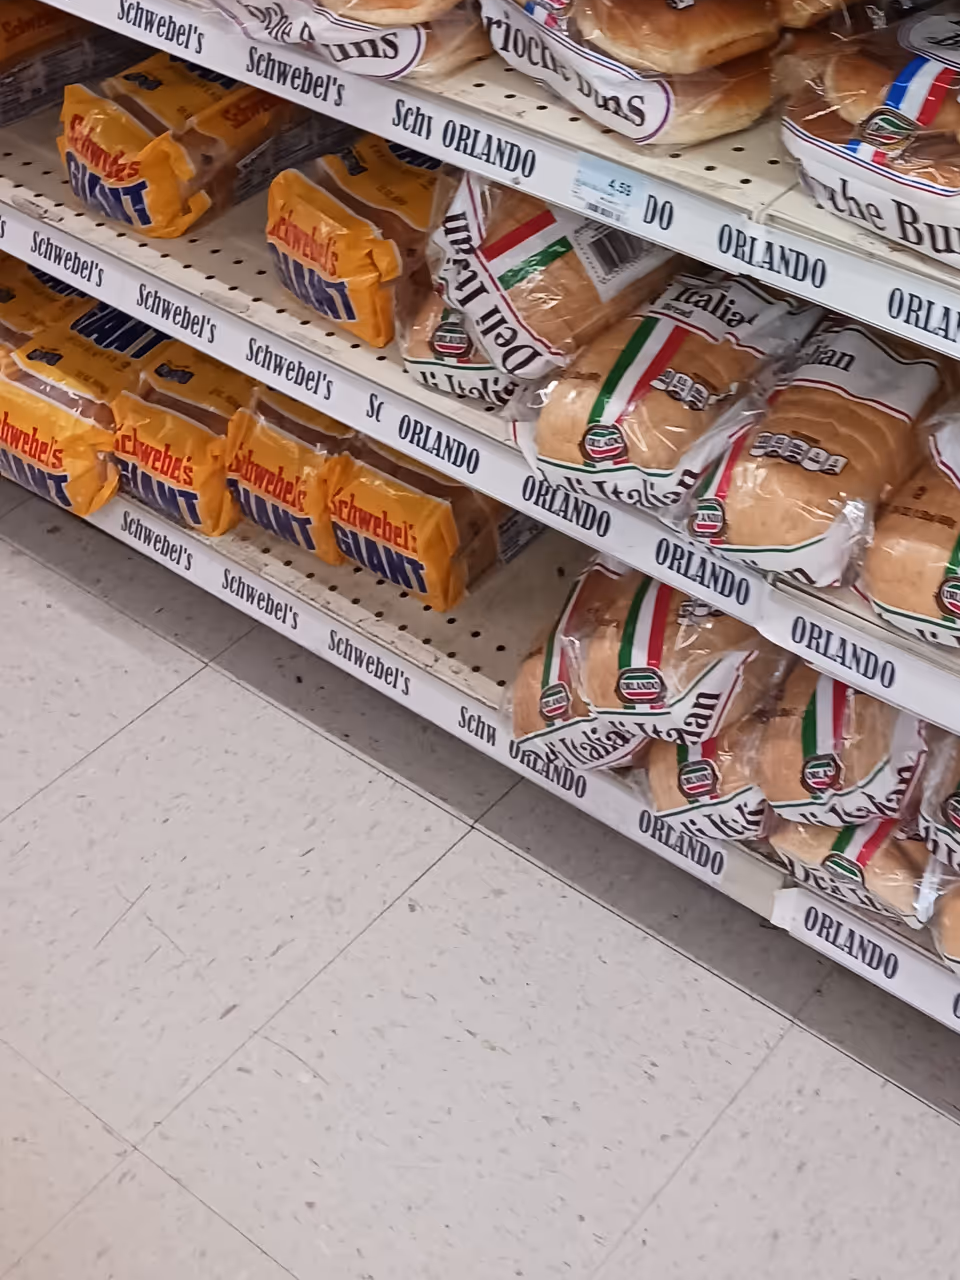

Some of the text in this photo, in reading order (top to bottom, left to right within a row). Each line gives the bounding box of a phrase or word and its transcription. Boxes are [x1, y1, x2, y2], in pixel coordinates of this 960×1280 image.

[246, 46, 345, 107] Schwebel's
[484, 10, 572, 81] rioche
[442, 119, 537, 179] ORLANDO
[65, 150, 153, 226] GIANT
[31, 231, 105, 288] Schwebel's
[718, 223, 827, 289] ORLANDO
[136, 283, 217, 344] Schwebel's
[477, 304, 544, 374] Deli
[246, 337, 333, 401] Schwebel's
[399, 414, 480, 474] ORLANDO
[523, 474, 611, 537] ORLANDO
[592, 469, 699, 508] Italian
[121, 510, 194, 572] Schwebel's
[333, 521, 429, 594] GIANT
[655, 537, 750, 606] ORLANDO
[222, 568, 300, 631] Schwebel's
[328, 630, 411, 696] Schwebel's
[791, 616, 896, 689] ORLANDO
[620, 680, 660, 693] ORLANDO
[508, 738, 588, 799] ORLANDO
[639, 808, 725, 876] ORLANDO
[804, 907, 899, 980] ORLANDO
